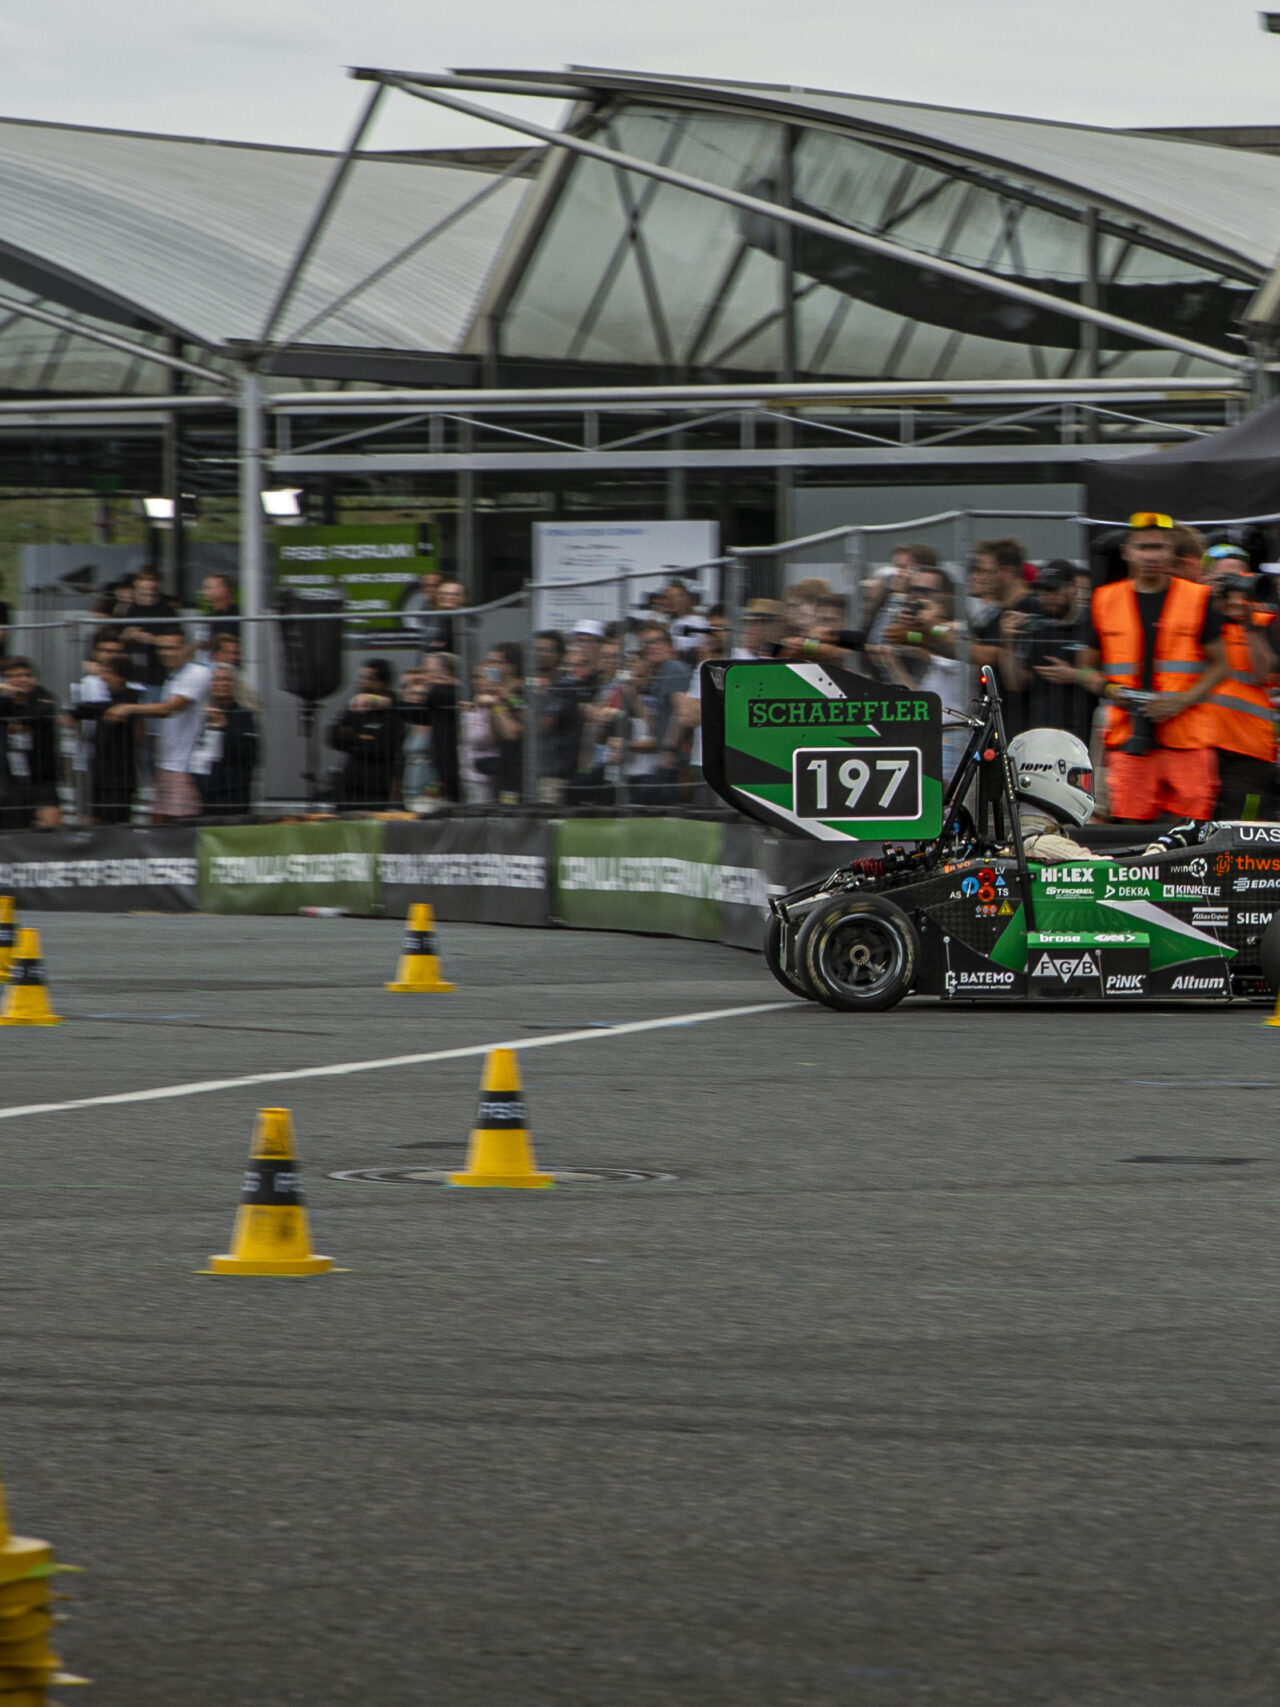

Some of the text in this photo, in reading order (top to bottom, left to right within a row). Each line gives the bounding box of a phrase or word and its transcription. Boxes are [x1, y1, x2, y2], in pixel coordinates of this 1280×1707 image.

[753, 701, 930, 723] SCHAEFFLER
[807, 759, 910, 809] 197
[1108, 866, 1160, 882] LEONI
[949, 891, 962, 899] AS
[997, 888, 1009, 897] TS
[1118, 886, 1150, 897] DEKRA
[1176, 885, 1221, 897] KINKELE
[1040, 934, 1081, 943] brose
[960, 972, 1015, 984] BATEMO
[1171, 976, 1225, 990] Altium
